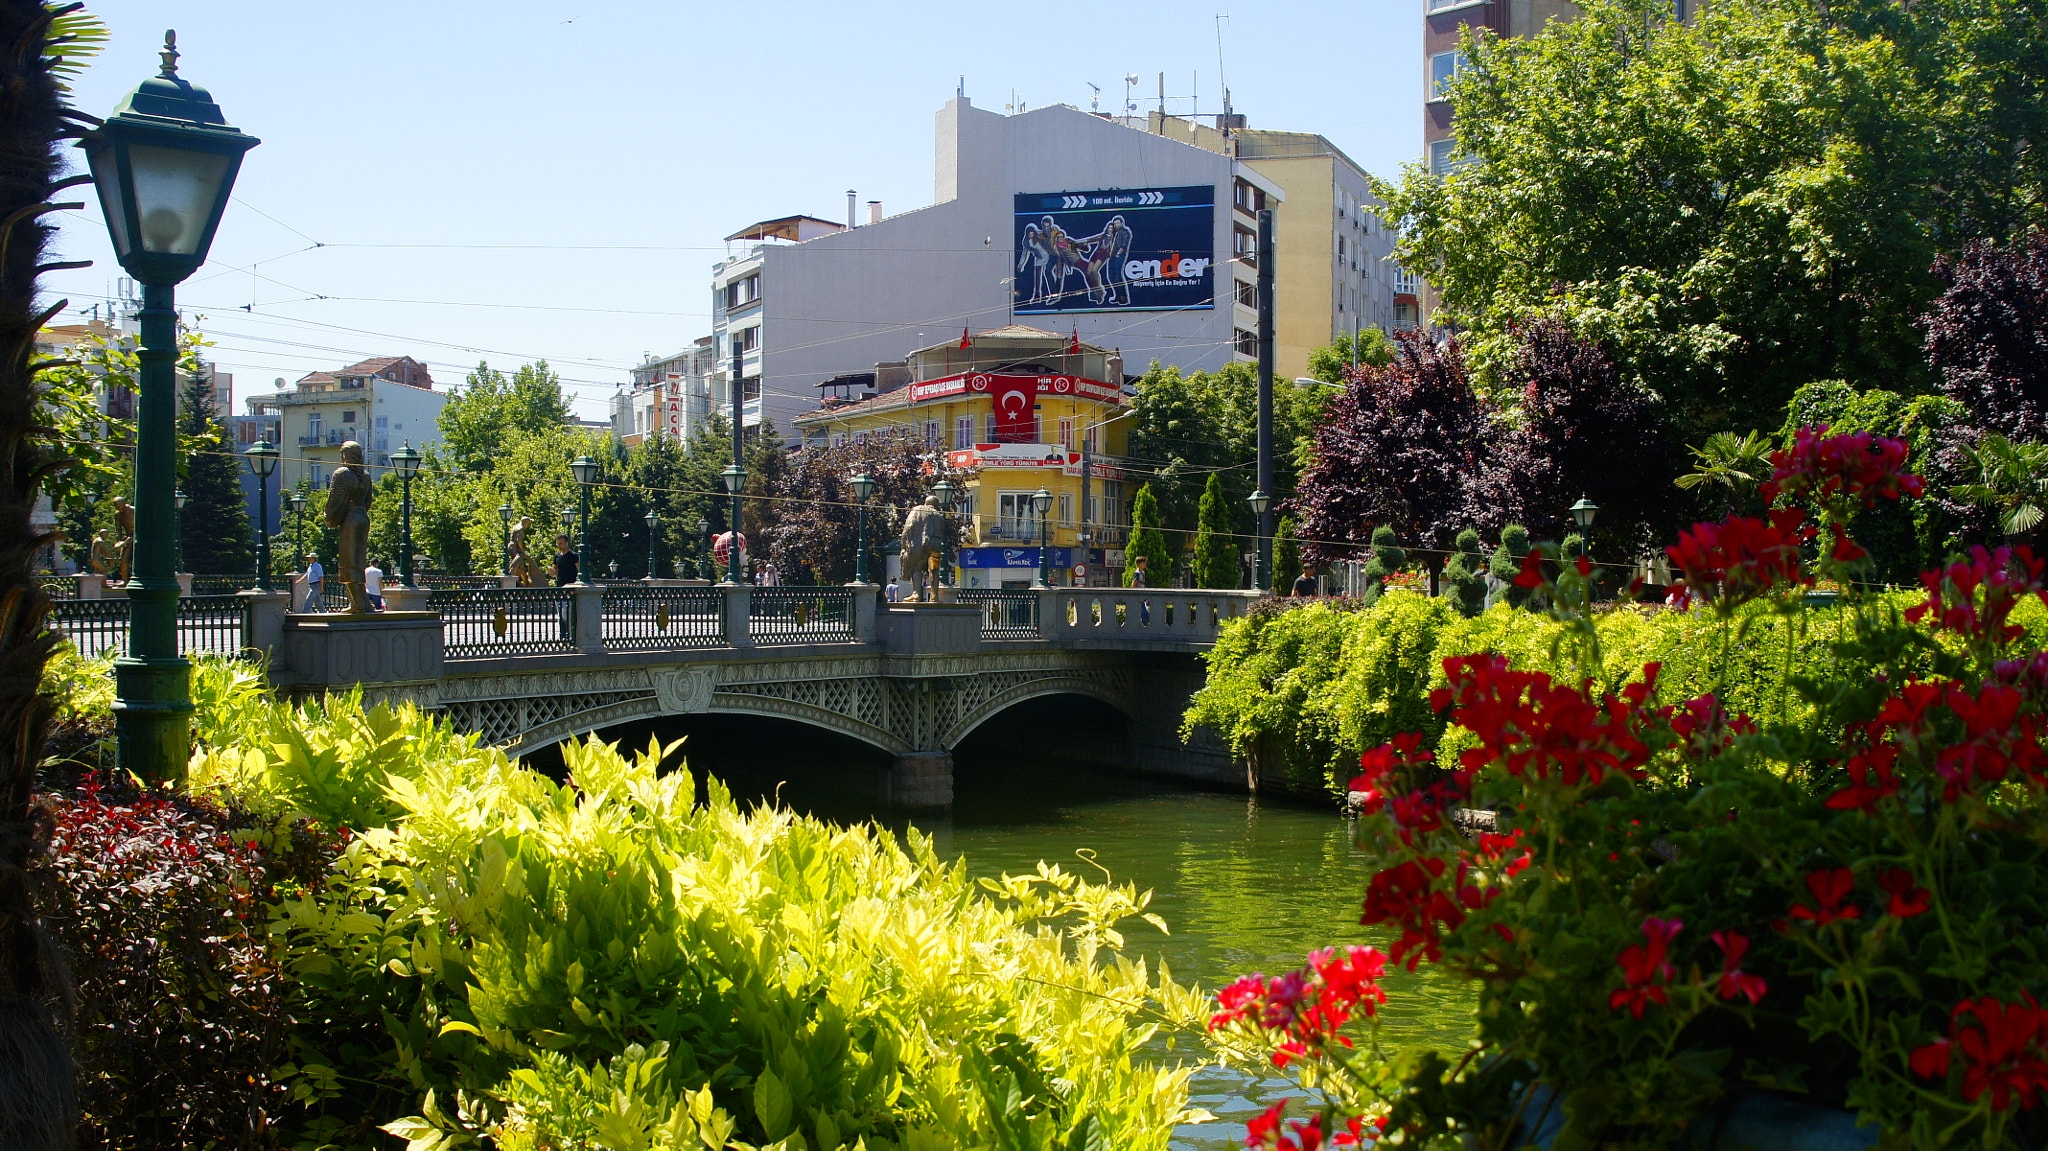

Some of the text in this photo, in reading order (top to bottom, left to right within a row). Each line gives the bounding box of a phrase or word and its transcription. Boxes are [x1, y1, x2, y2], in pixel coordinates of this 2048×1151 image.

[1092, 197, 1103, 205] 100
[1125, 254, 1209, 279] ender
[1036, 376, 1052, 384] HİR
